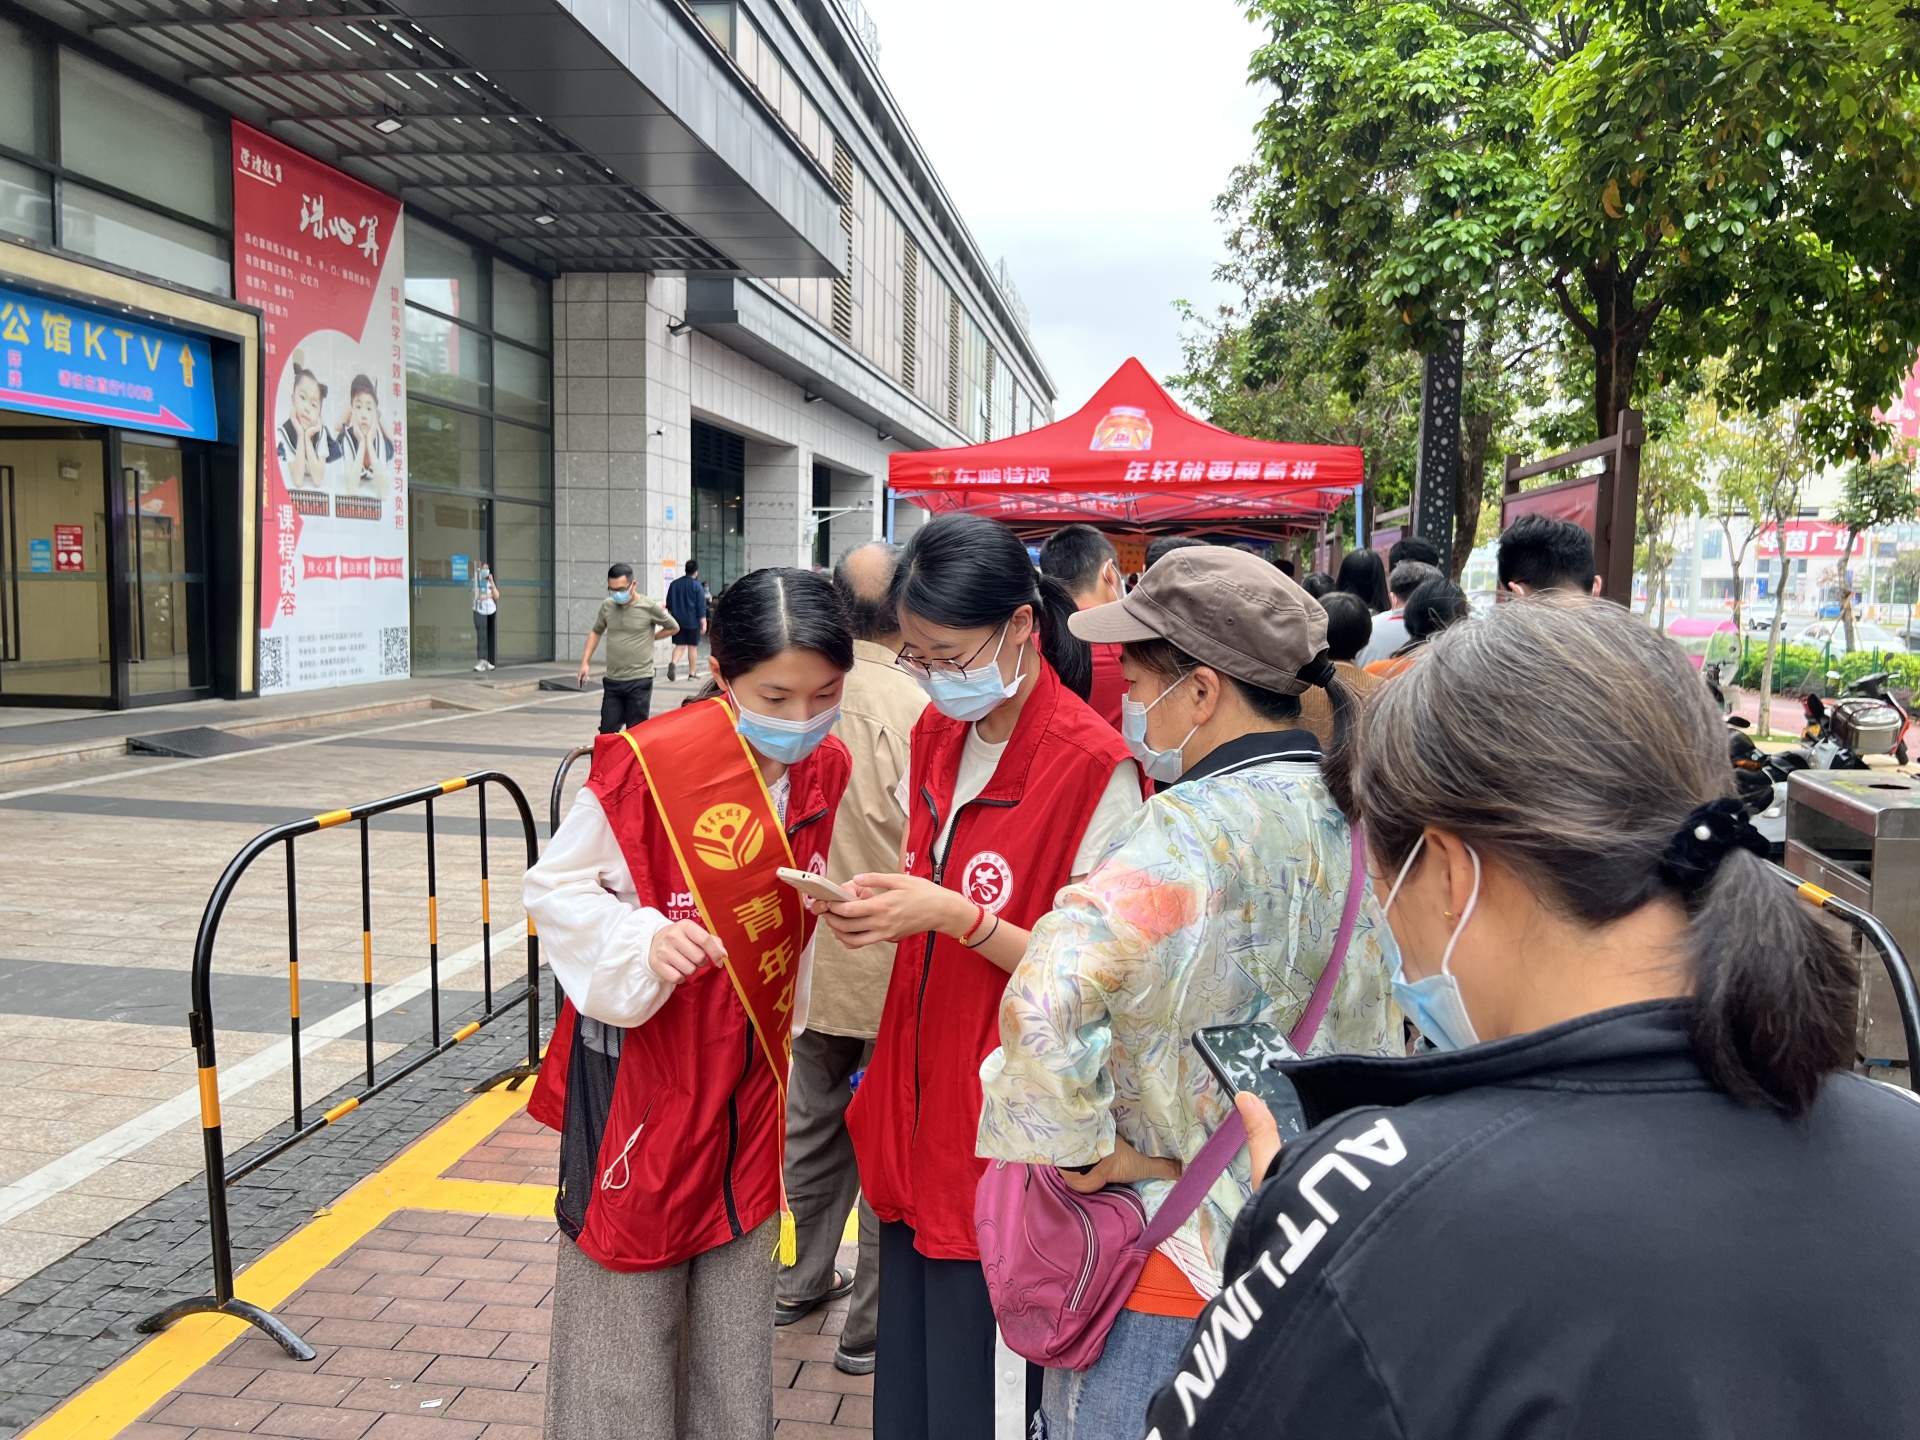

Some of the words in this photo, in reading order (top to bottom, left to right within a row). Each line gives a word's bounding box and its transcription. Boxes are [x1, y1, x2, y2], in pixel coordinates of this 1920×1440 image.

[299, 193, 380, 267] 珠心算
[953, 466, 1050, 485] 东鹏特饮
[1124, 460, 1319, 483] 年轻就要醒着拼
[277, 504, 297, 617] 课程内容
[732, 889, 796, 1064] 青年文
[1174, 1117, 1407, 1428] AUTUMN
